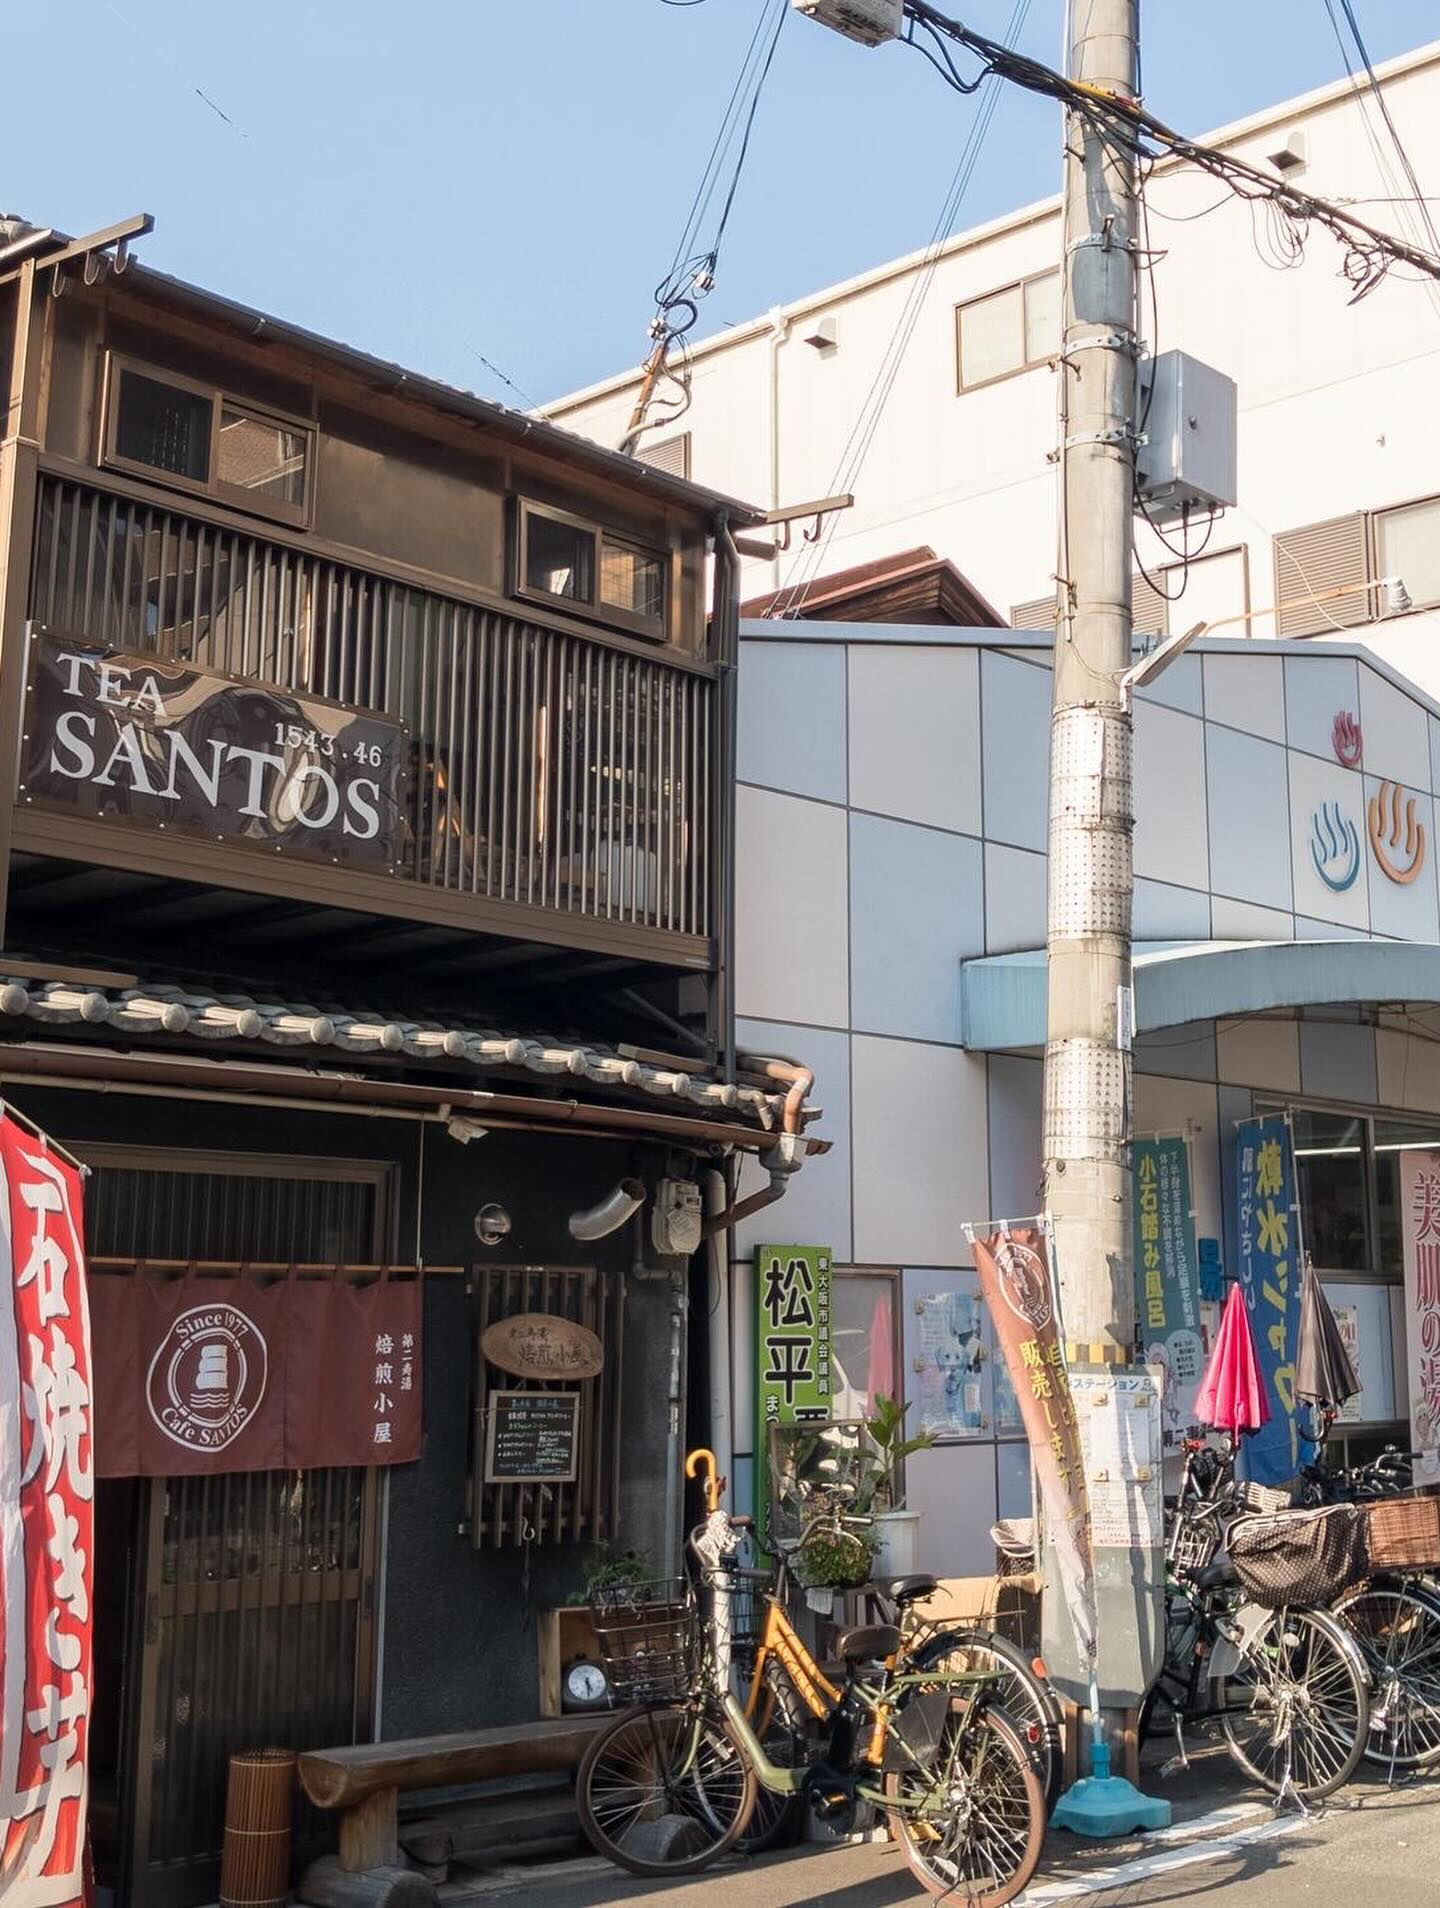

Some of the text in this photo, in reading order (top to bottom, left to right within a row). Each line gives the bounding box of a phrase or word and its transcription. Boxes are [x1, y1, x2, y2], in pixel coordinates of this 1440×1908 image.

[56, 652, 167, 717] TEA
[50, 711, 380, 840] SANTOS
[1138, 1153, 1166, 1329] 小石踏み風呂
[175, 1312, 250, 1339] Since 1977
[817, 1256, 830, 1397] 東大阪市議会議員
[161, 1403, 249, 1446] Cafe SANTOS
[373, 1333, 395, 1444] 焙煎小屋
[1068, 1378, 1140, 1392] ステーション
